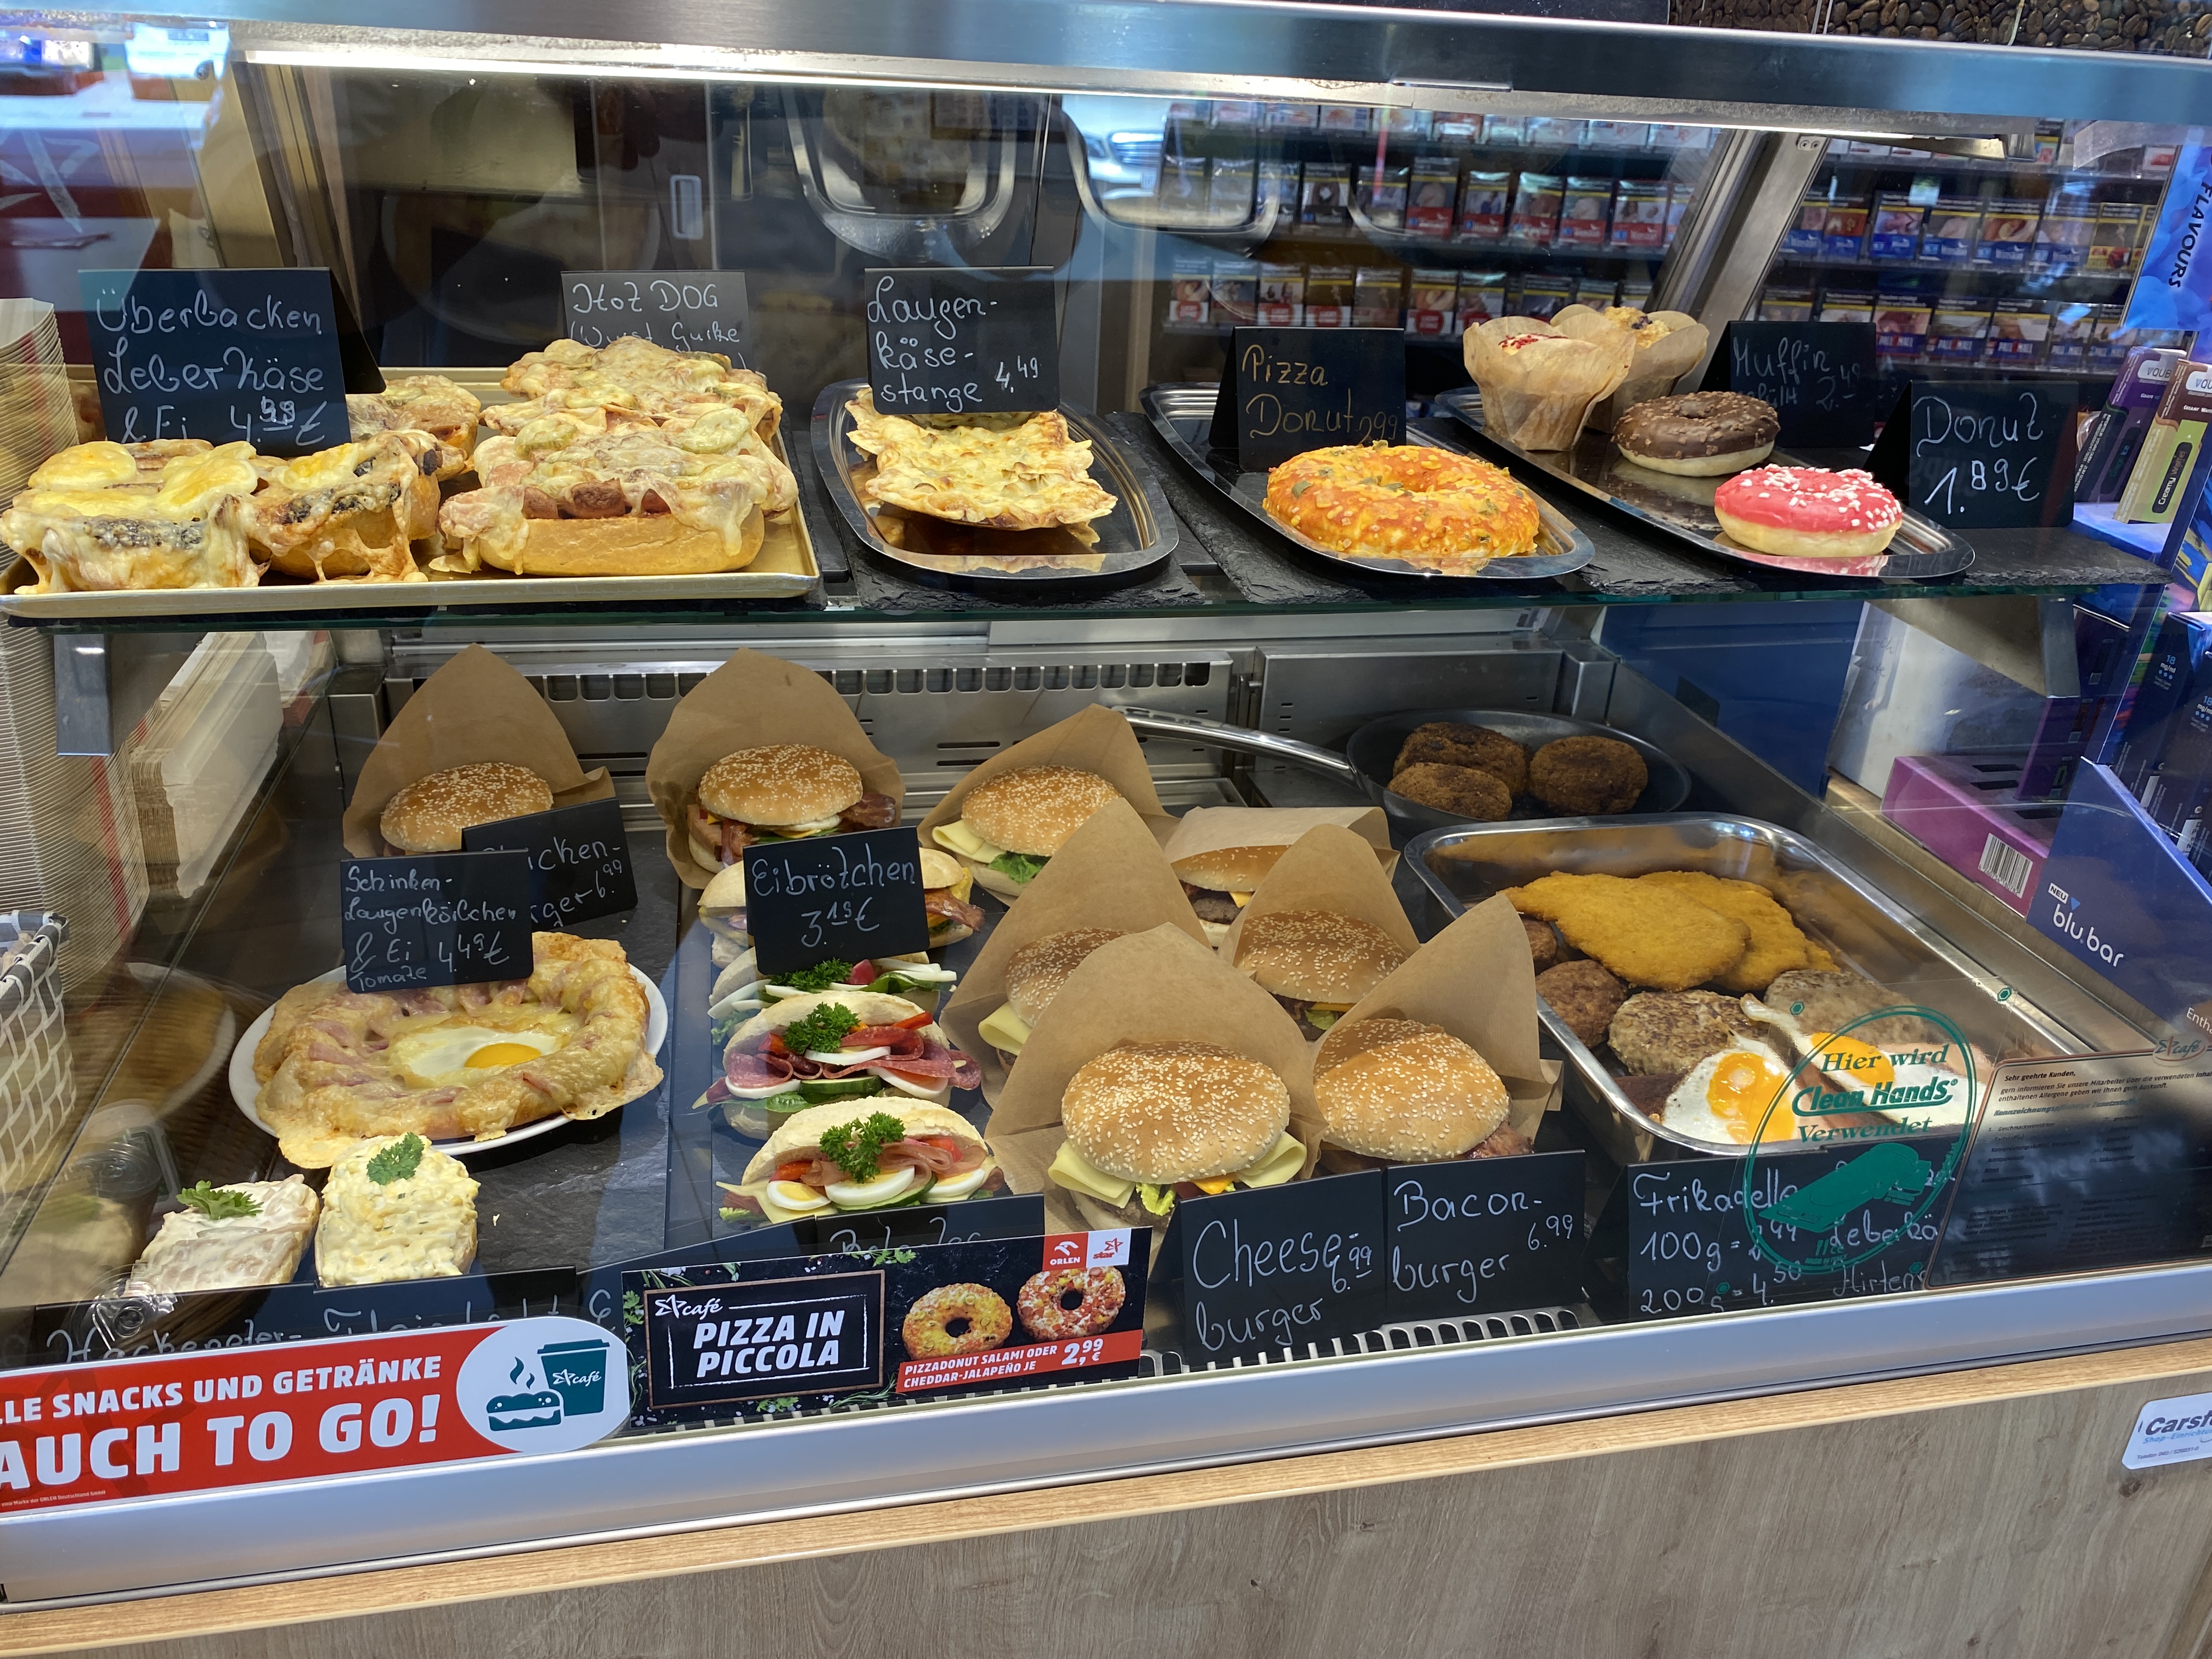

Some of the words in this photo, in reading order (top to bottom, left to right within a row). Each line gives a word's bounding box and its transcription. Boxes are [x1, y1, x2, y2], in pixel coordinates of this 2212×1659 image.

[2169, 182, 2212, 288] FLAVOURS
[650, 280, 719, 312] DOG
[867, 275, 997, 340] Laugen-
[876, 330, 974, 370] käse-
[1242, 344, 1328, 386] Pizza
[1733, 336, 1830, 385] Muffin
[880, 372, 983, 413] stange
[1245, 387, 1353, 439] Donut
[1912, 391, 2044, 458] Donut
[2158, 477, 2176, 505] Creamy
[2167, 655, 2176, 665] 18
[752, 843, 916, 896] Eibrötchen
[2050, 885, 2067, 901] NEU
[2053, 903, 2084, 940] blu
[2086, 926, 2124, 968] bar
[1820, 1051, 1882, 1073] Hier
[1888, 1043, 1950, 1067] wird
[2172, 1040, 2202, 1058] café
[1998, 1093, 2040, 1102] enthaltenen
[2039, 1091, 2069, 1099] Allergene
[2070, 1089, 2090, 1097] geben
[2103, 1085, 2122, 1093] Ihnen
[2123, 1085, 2137, 1093] gern
[2017, 1084, 2055, 1093] informieren
[2090, 1077, 2125, 1086] Mitarbeiter
[2154, 1073, 2194, 1081] verwendeten
[2021, 1073, 2047, 1081] geehrte
[1792, 1085, 1865, 1117] Clean
[1797, 1116, 1933, 1143] Verwendet
[1393, 1180, 1543, 1232] Bacon-
[1049, 1256, 1080, 1266] ORLEN
[1192, 1217, 1359, 1289] Cheese-
[1640, 1231, 1722, 1272] 100g
[1391, 1244, 1510, 1304] burger
[682, 1298, 724, 1320] café
[1194, 1297, 1324, 1352] burger
[693, 1314, 795, 1349] PIZZA
[806, 1310, 845, 1339] IN
[572, 1370, 602, 1387] café
[696, 1340, 839, 1378] PICCOLA
[904, 1363, 1022, 1388] CHEDDAR-JALAPEÑO
[1023, 1360, 1036, 1372] JE
[905, 1356, 980, 1375] PIZZADONUT
[981, 1350, 1024, 1364] SALAMI
[1026, 1345, 1058, 1358] ODER
[53, 1382, 184, 1419] SNACKS
[193, 1375, 262, 1403] UND
[273, 1355, 442, 1395] GETRÄNKE
[0, 1421, 181, 1491] AUCH
[207, 1410, 293, 1466] TO
[318, 1393, 441, 1454] GO!
